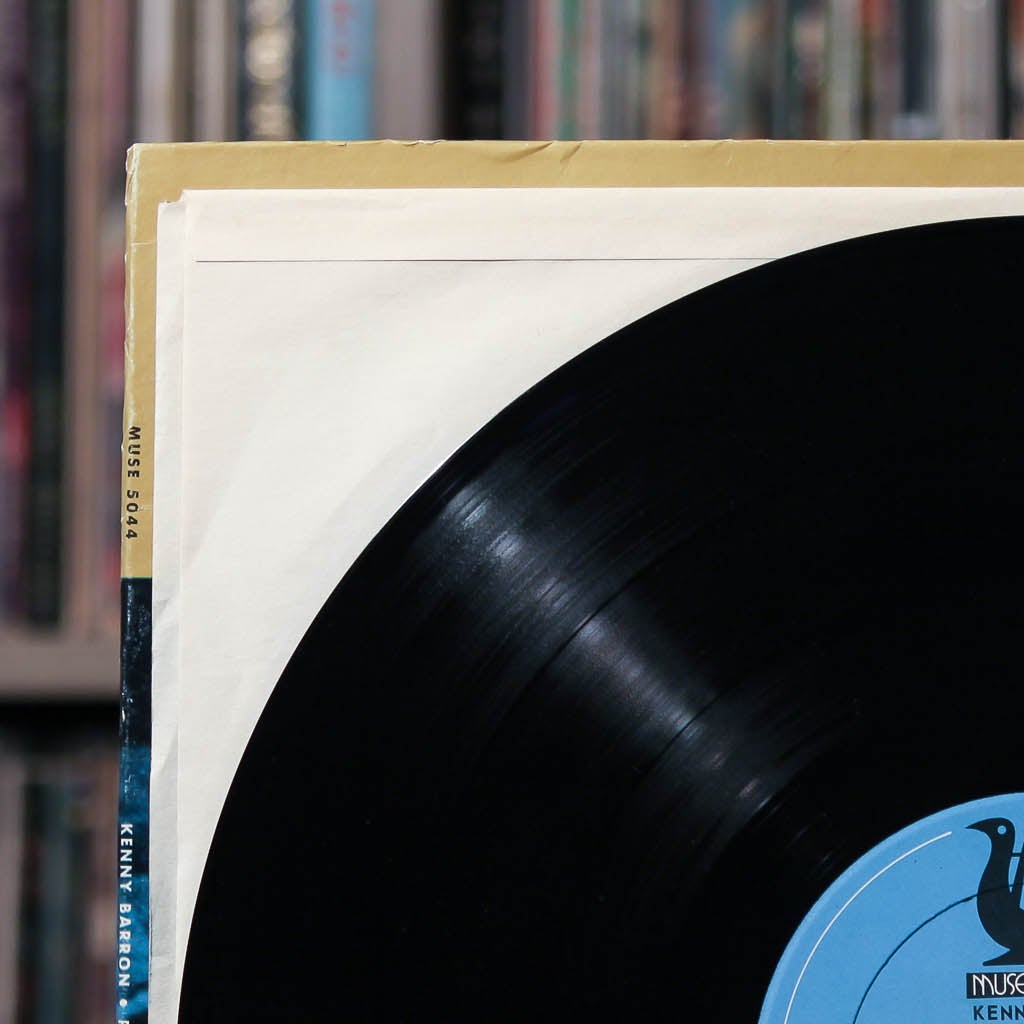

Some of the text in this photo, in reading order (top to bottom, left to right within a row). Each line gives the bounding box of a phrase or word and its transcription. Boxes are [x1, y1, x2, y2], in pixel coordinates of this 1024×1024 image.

[126, 426, 141, 540] MUSE 5044
[119, 823, 134, 893] KENNY
[118, 903, 132, 987] BARRON
